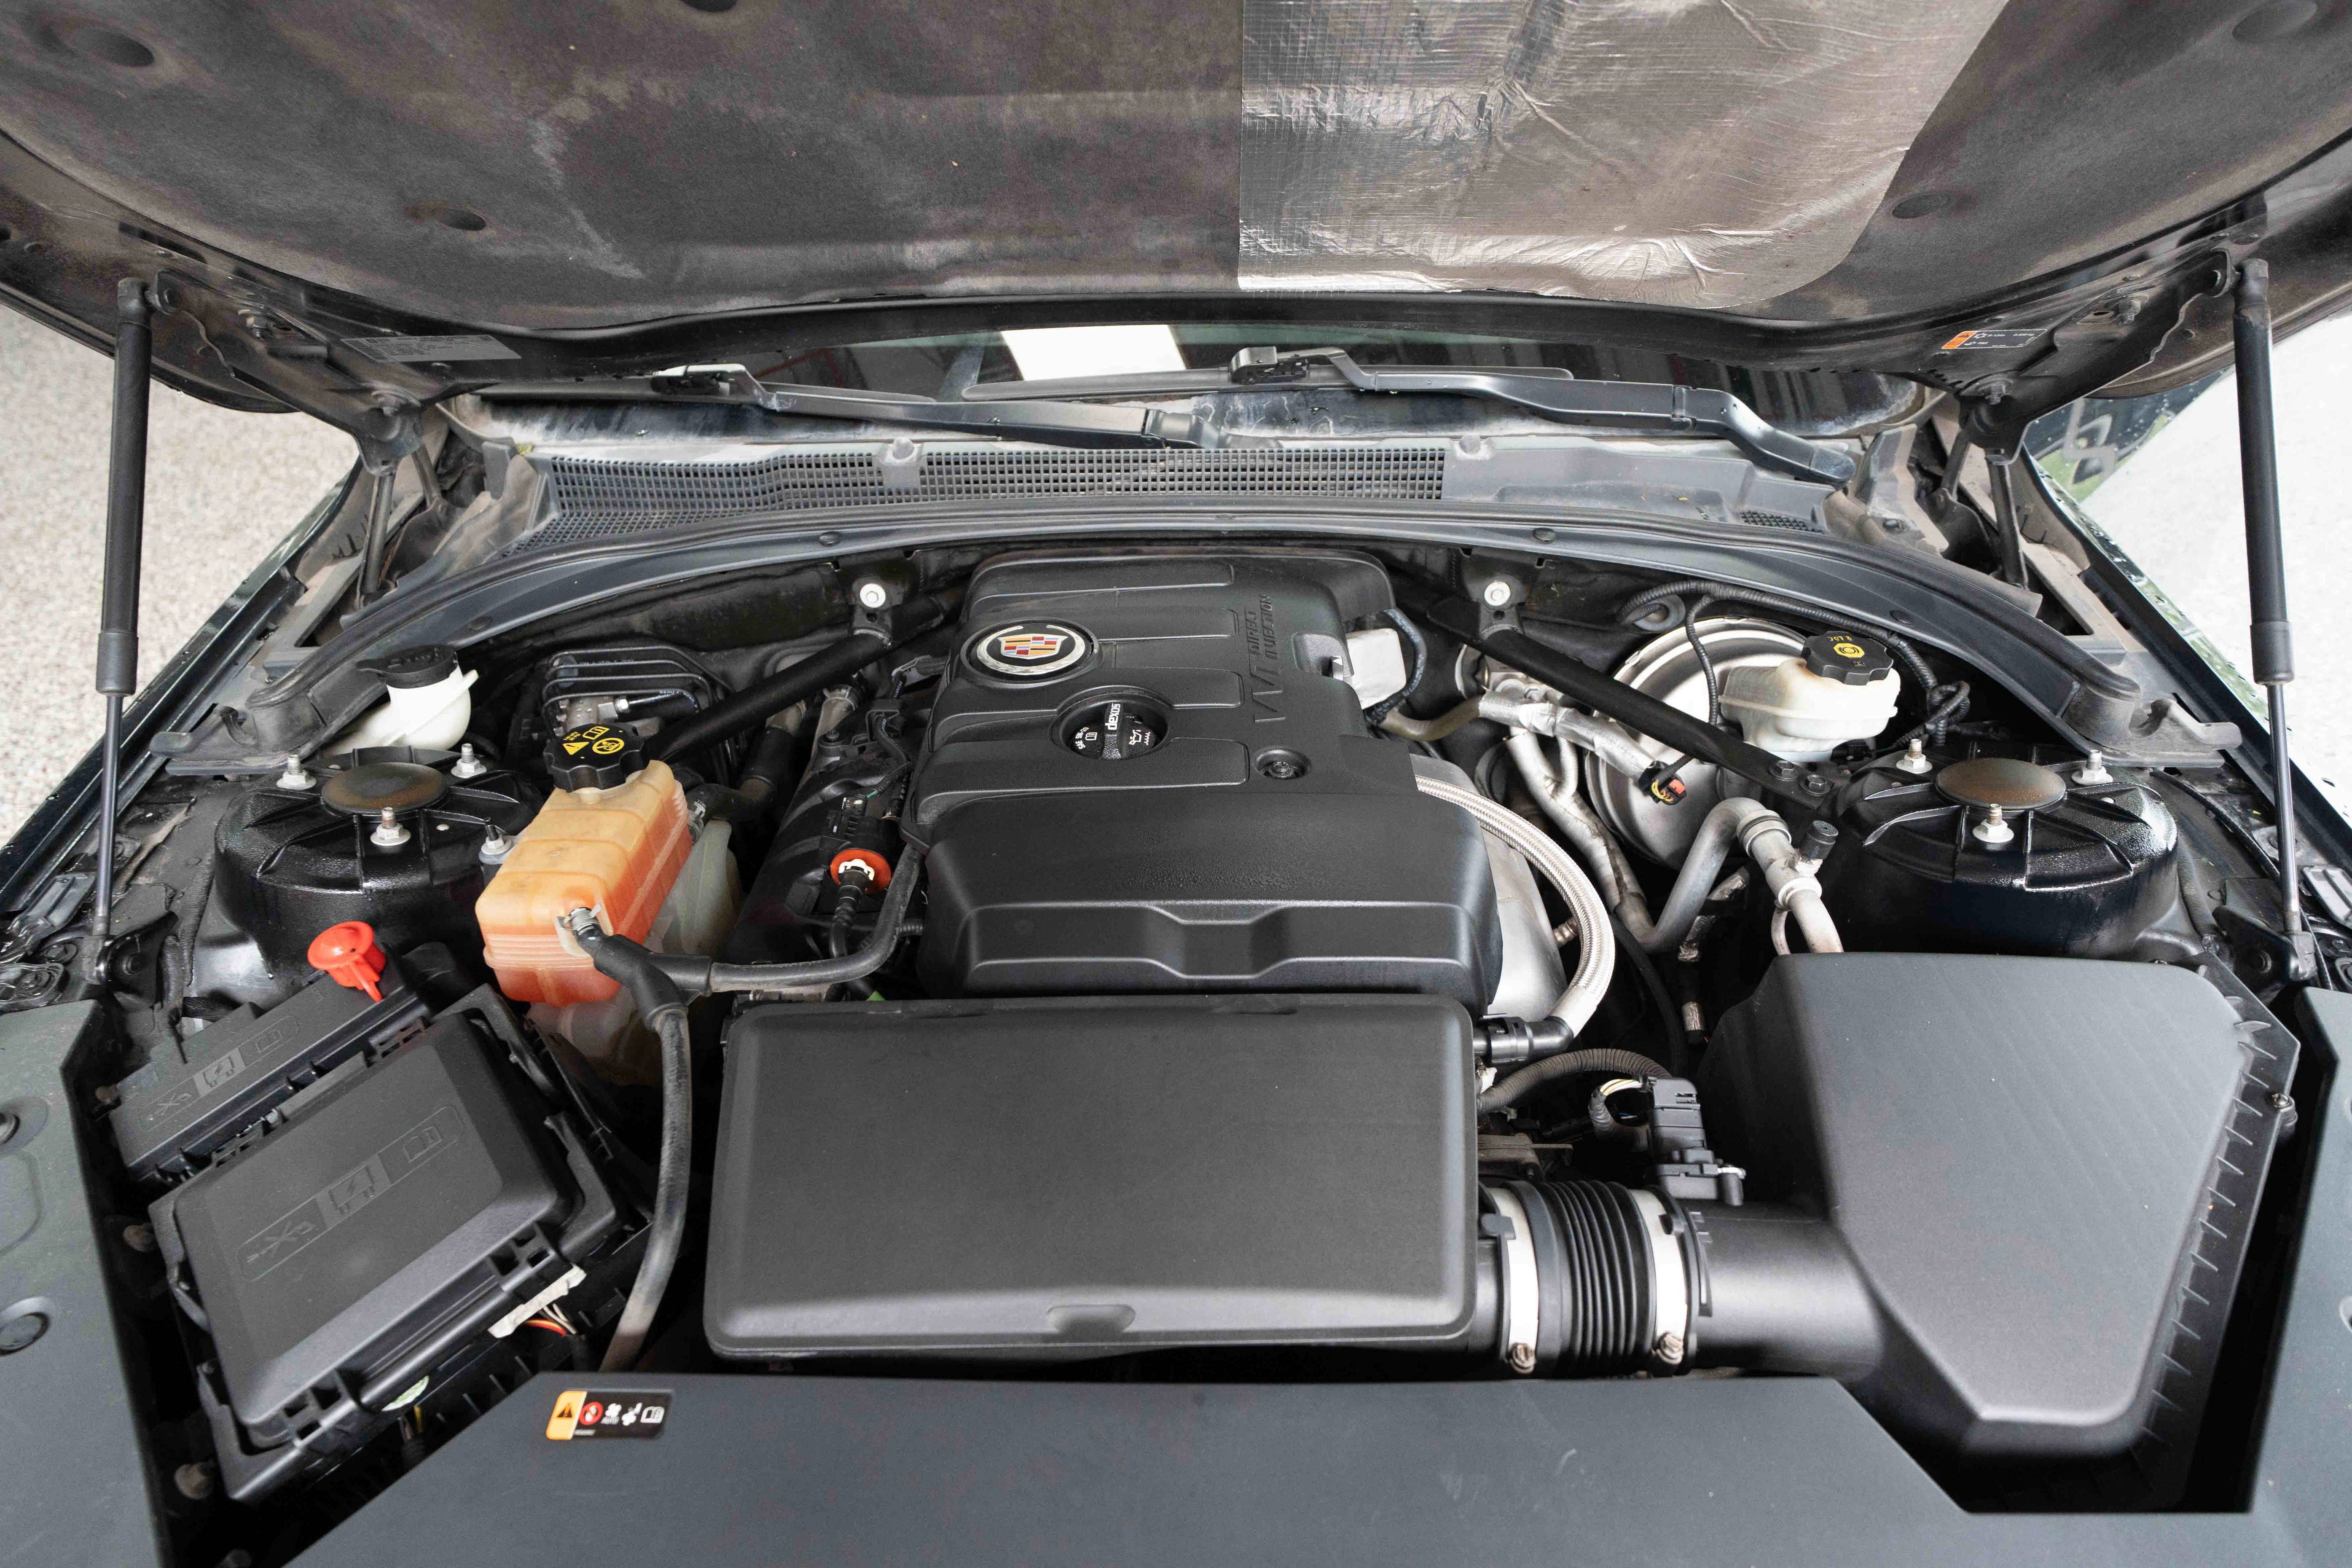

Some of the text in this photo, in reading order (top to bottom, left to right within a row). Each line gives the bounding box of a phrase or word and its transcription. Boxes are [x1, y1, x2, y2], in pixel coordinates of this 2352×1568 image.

[1105, 703, 1121, 731] dexos
[1075, 739, 1086, 749] SAE
[601, 1416, 620, 1425] AUTO
